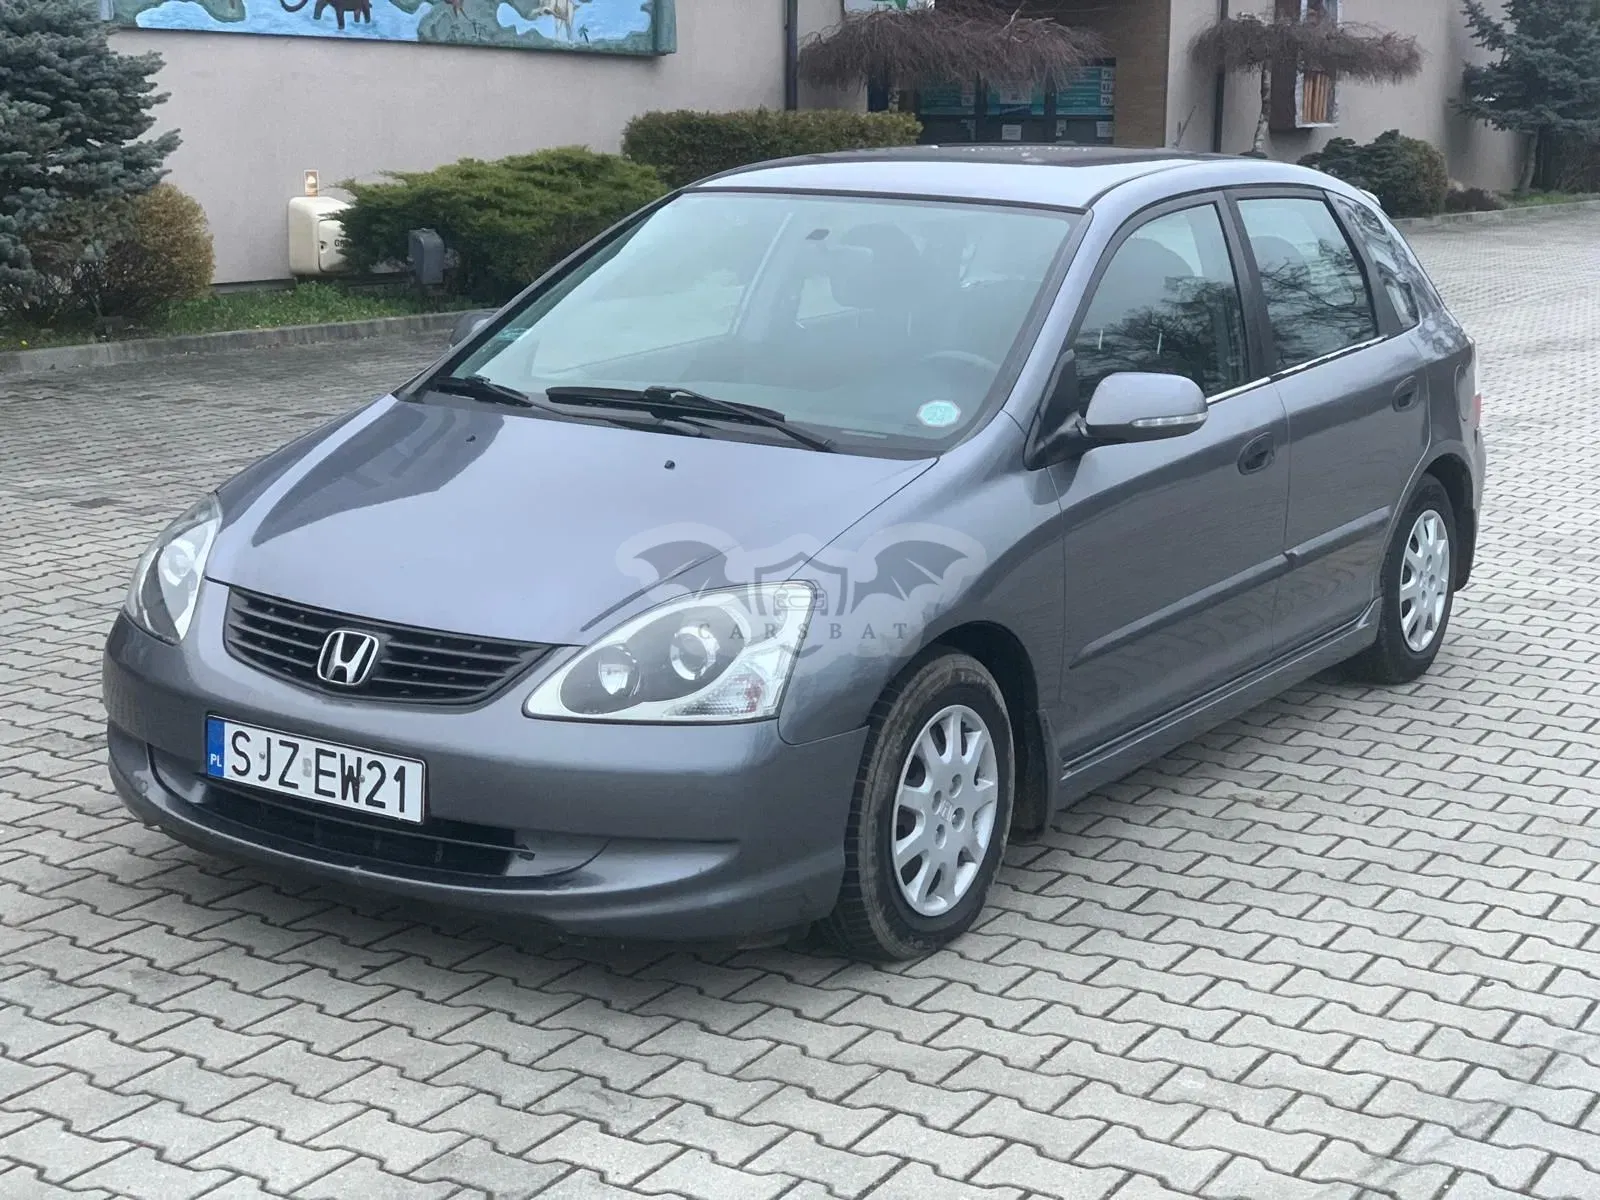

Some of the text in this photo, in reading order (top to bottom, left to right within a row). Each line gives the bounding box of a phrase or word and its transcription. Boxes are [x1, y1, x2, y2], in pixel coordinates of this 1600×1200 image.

[210, 754, 222, 768] PL
[231, 730, 406, 813] SJZ EW21
